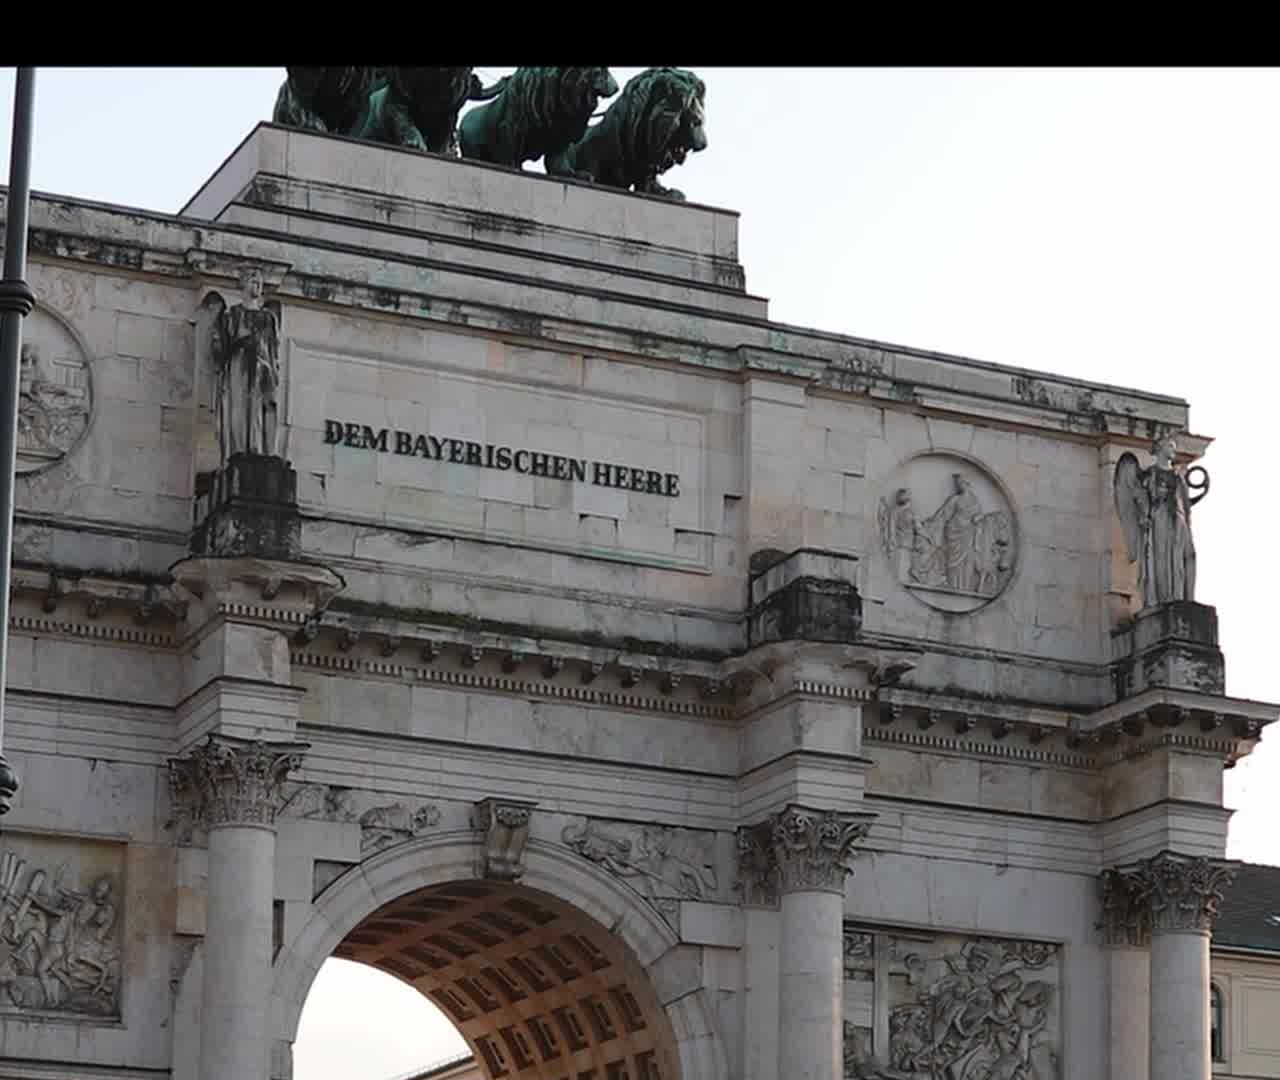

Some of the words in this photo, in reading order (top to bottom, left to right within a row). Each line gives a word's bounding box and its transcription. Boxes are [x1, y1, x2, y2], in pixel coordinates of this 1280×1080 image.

[324, 419, 387, 453] DEM
[395, 429, 586, 483] BAYERISCHEN
[592, 461, 681, 498] HEERE
